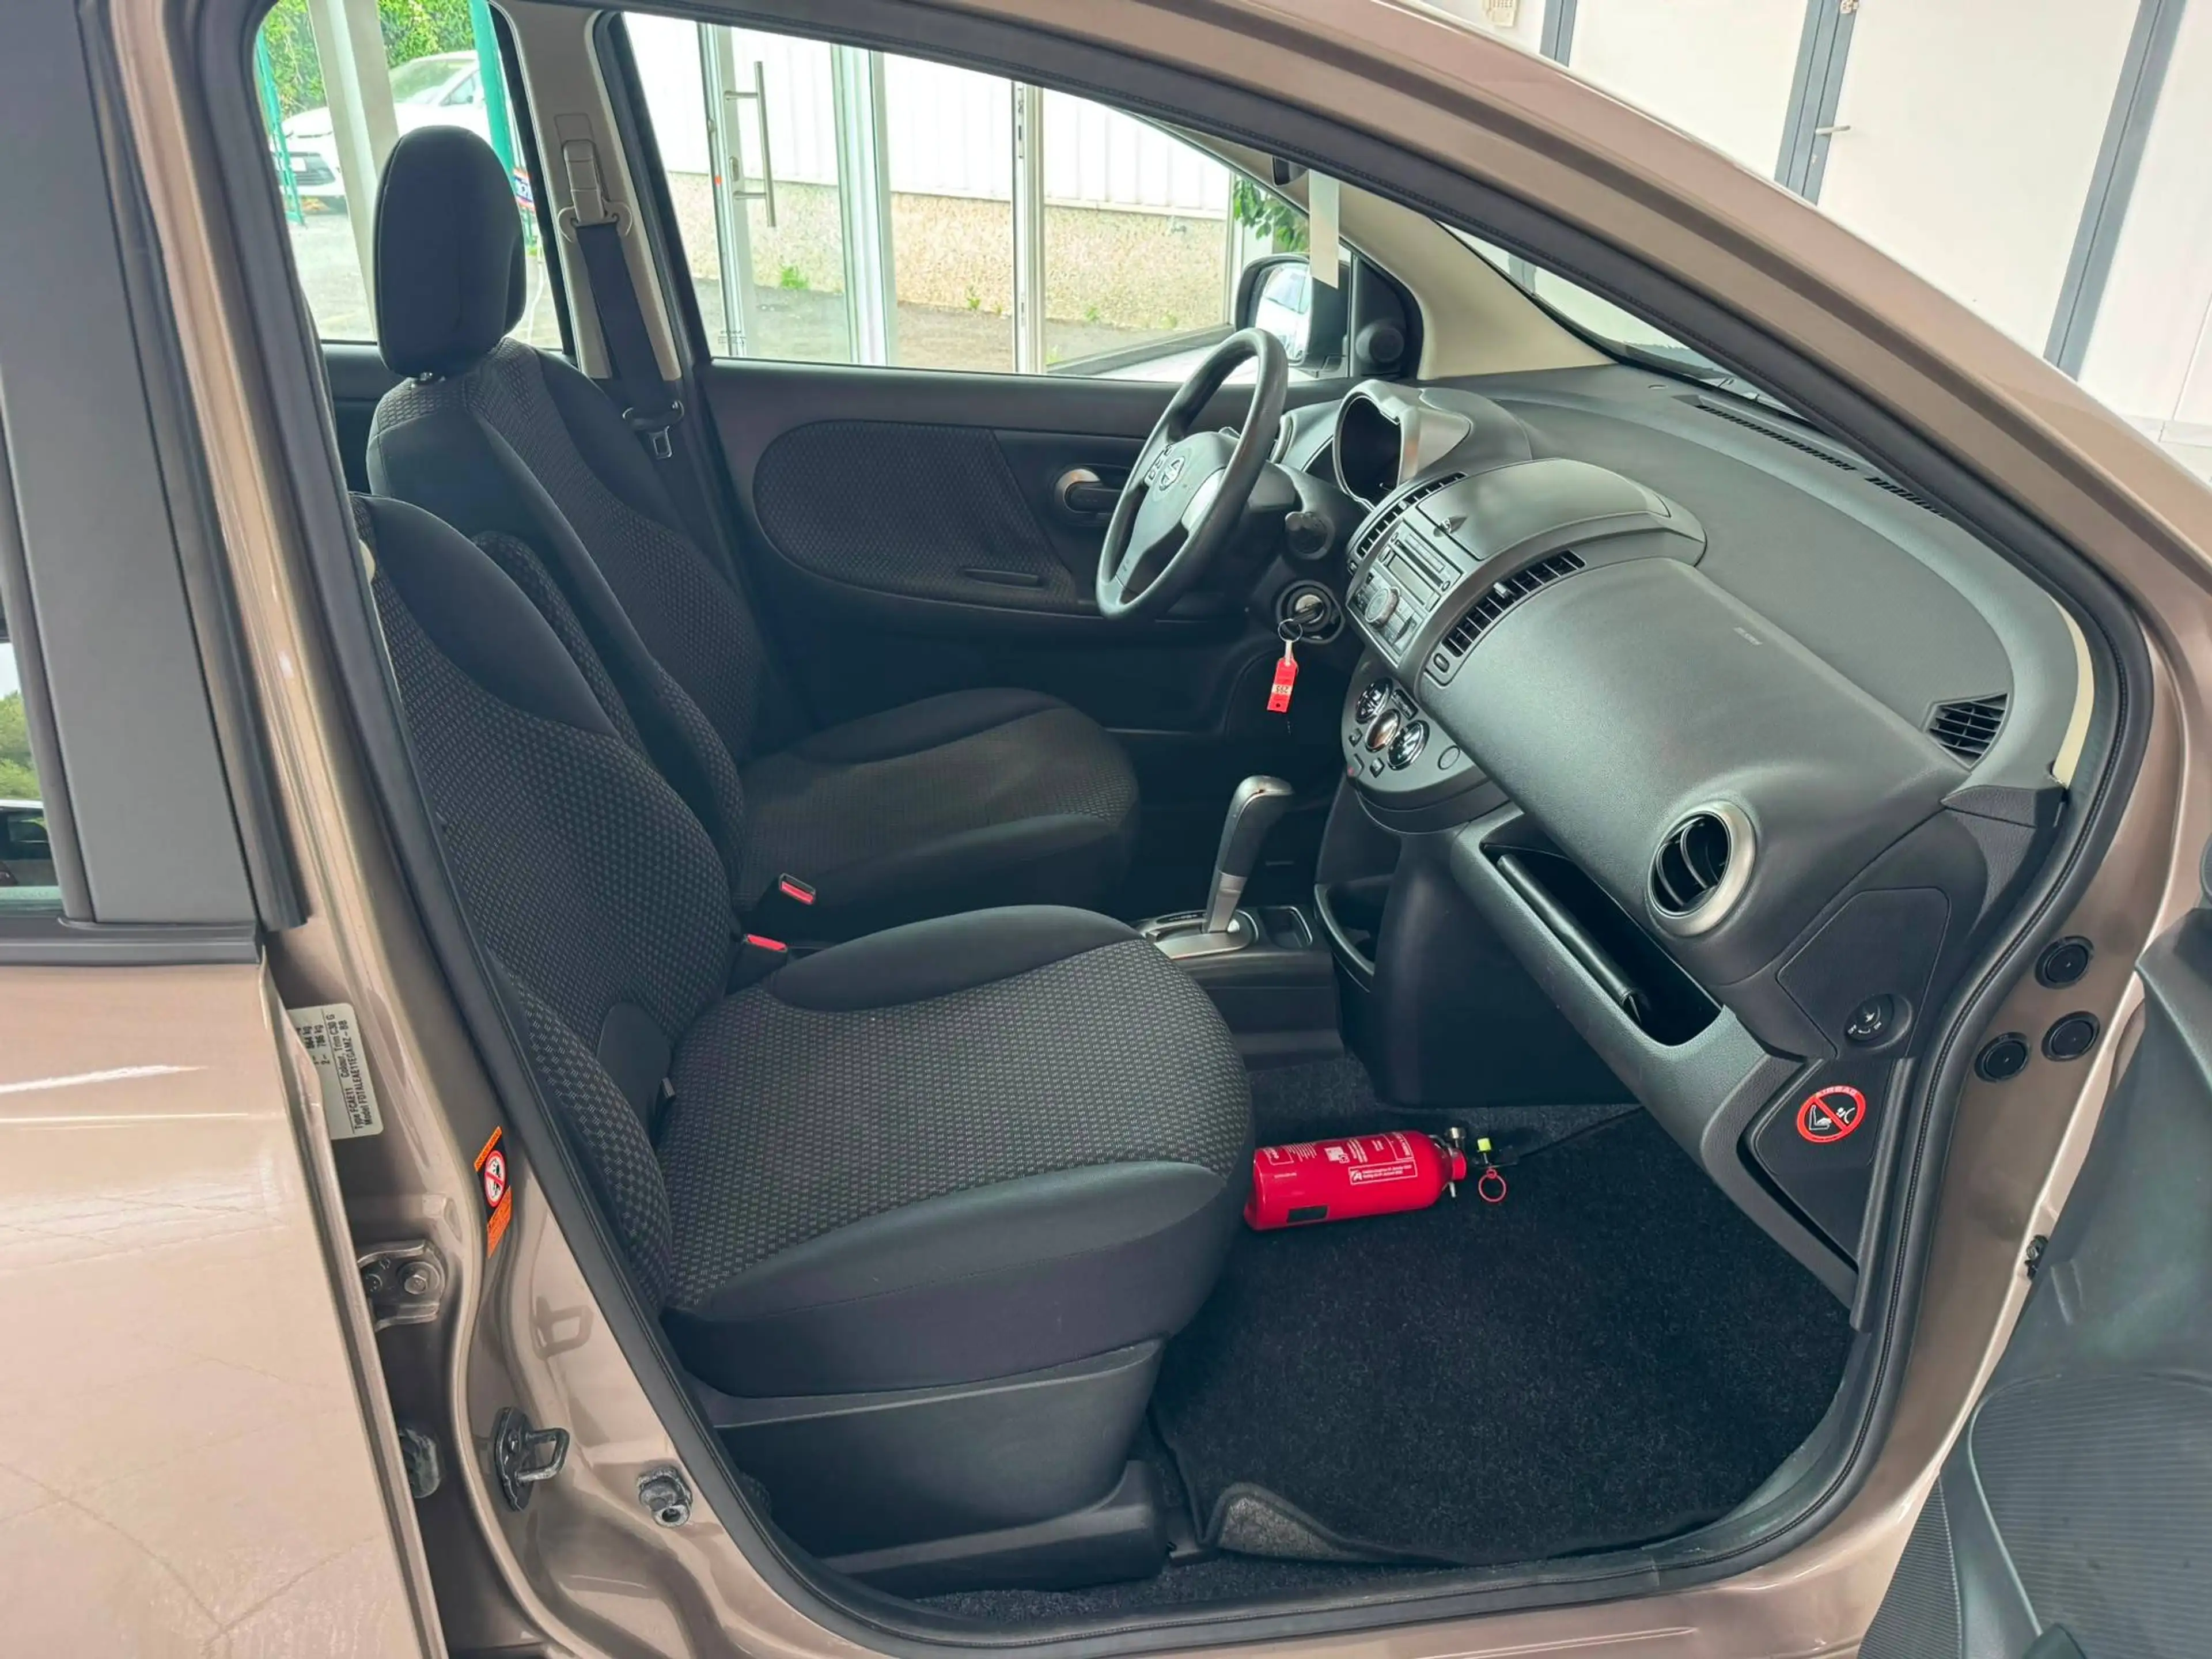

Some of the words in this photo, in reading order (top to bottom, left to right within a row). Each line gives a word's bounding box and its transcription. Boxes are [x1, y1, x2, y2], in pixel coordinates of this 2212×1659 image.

[332, 1036, 343, 1052] Trim
[353, 1112, 365, 1129] Type
[362, 1105, 373, 1125] Model
